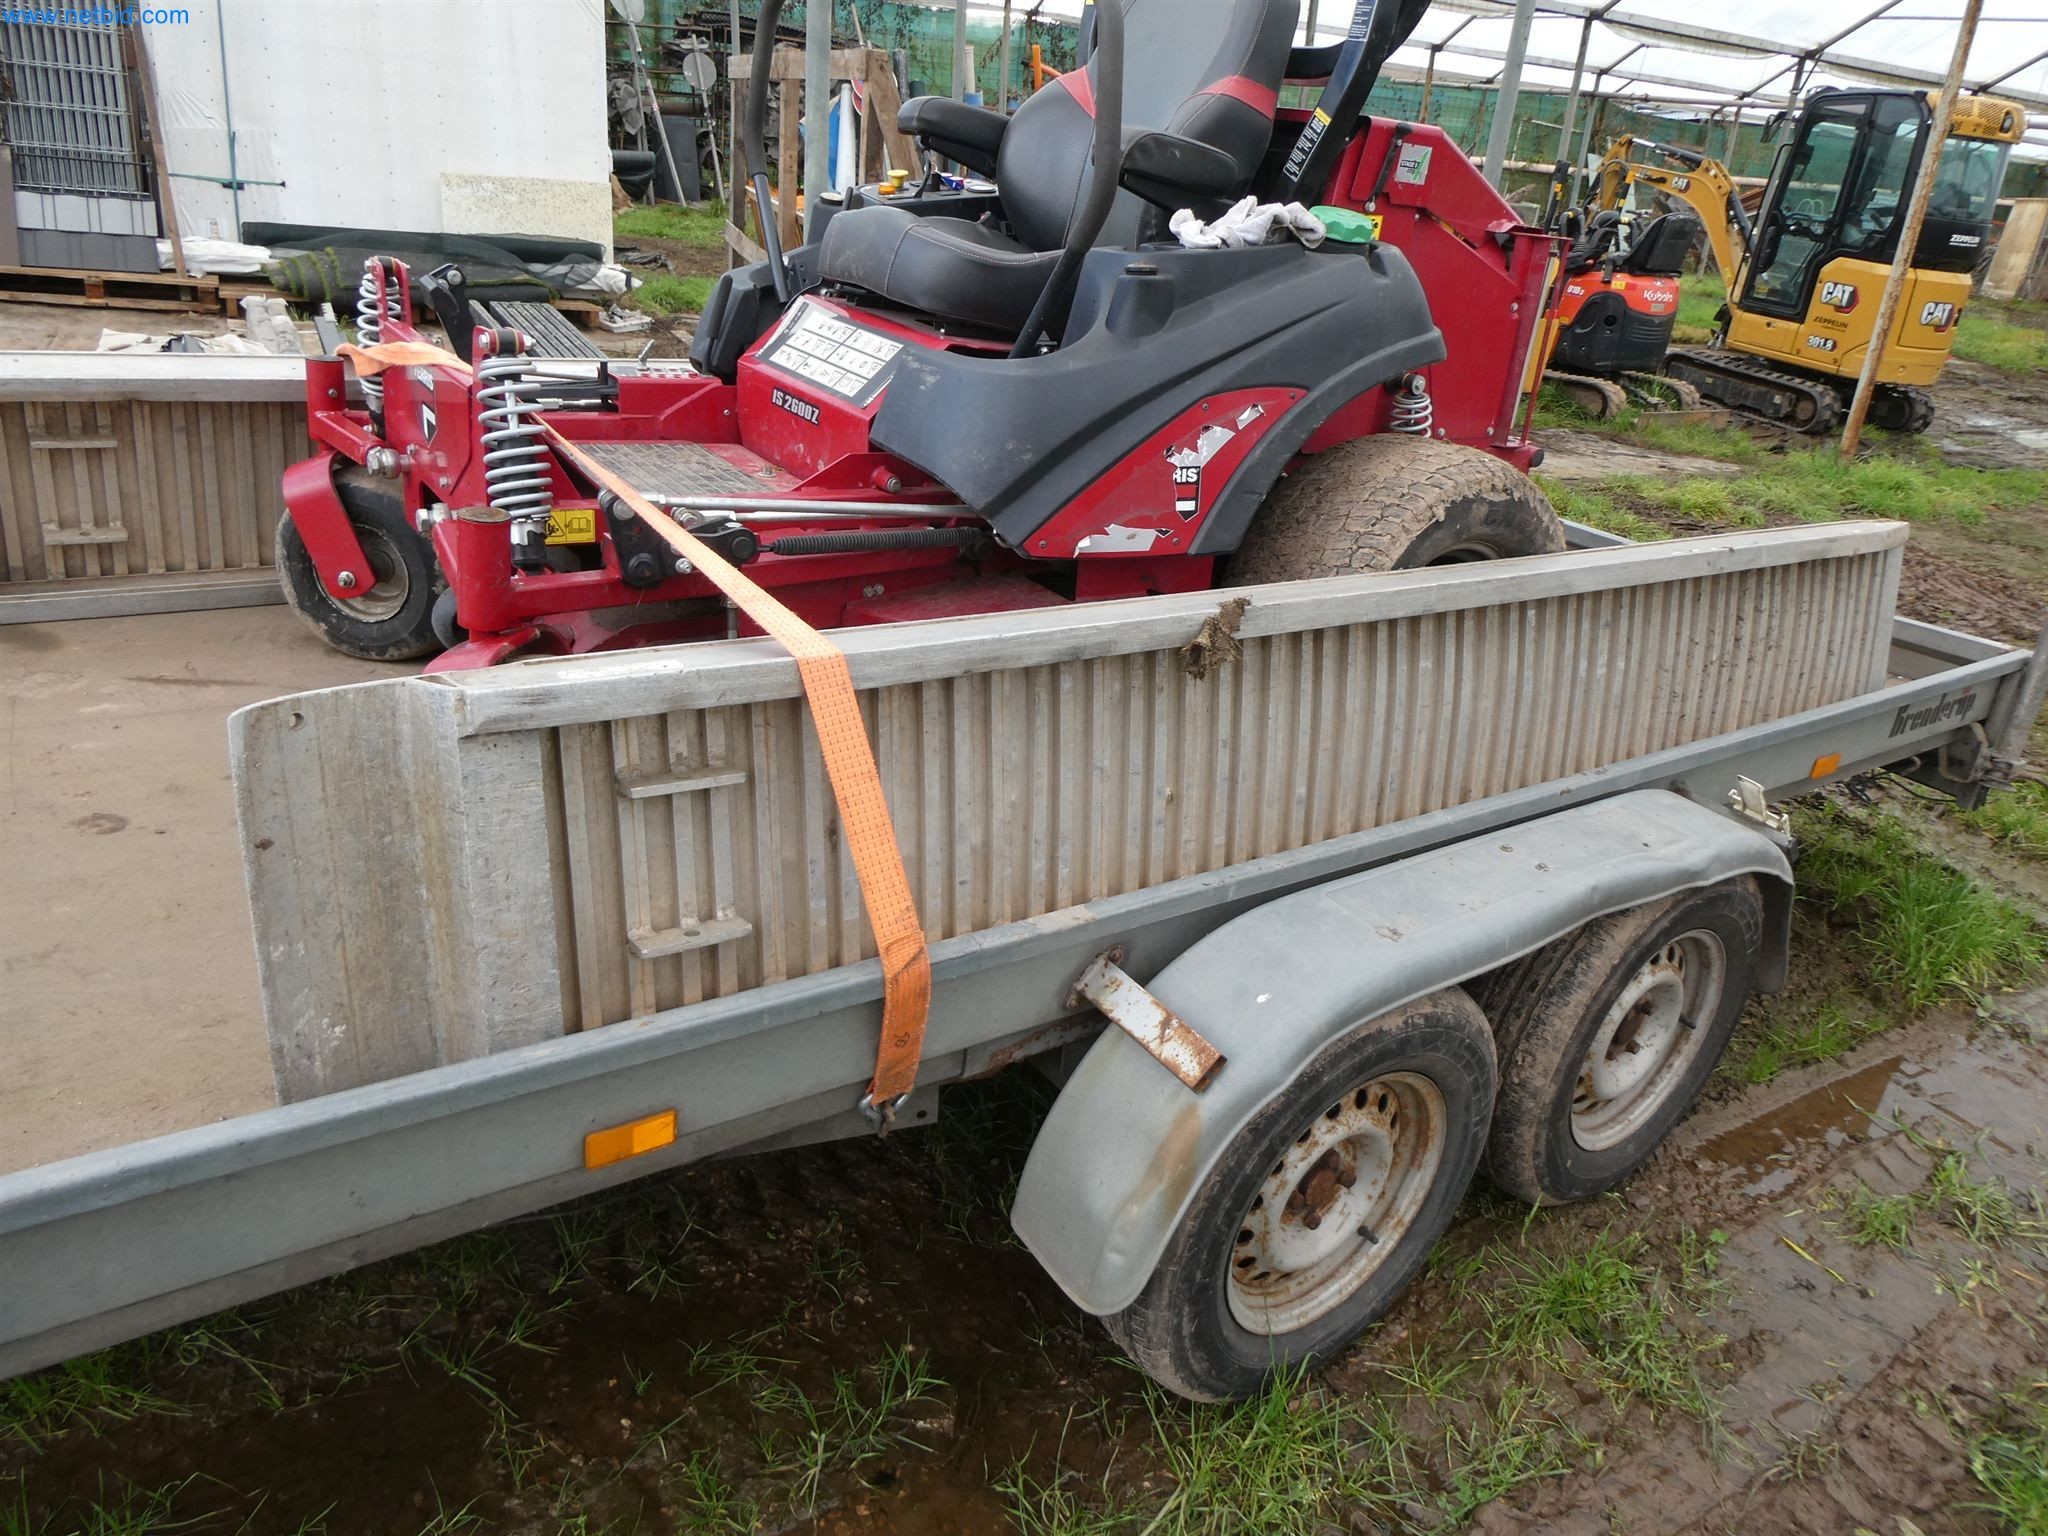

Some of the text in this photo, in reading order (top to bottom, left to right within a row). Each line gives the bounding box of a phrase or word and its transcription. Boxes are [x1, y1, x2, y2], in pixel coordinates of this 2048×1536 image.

[1672, 176, 1689, 190] CAT
[1643, 290, 1674, 302] Kubota
[1821, 282, 1855, 307] CAT
[1921, 302, 1953, 326] CAT
[1814, 316, 1849, 329] ZEPPELIN
[1807, 335, 1835, 351] 301.8
[772, 388, 820, 425] IS 2600Z
